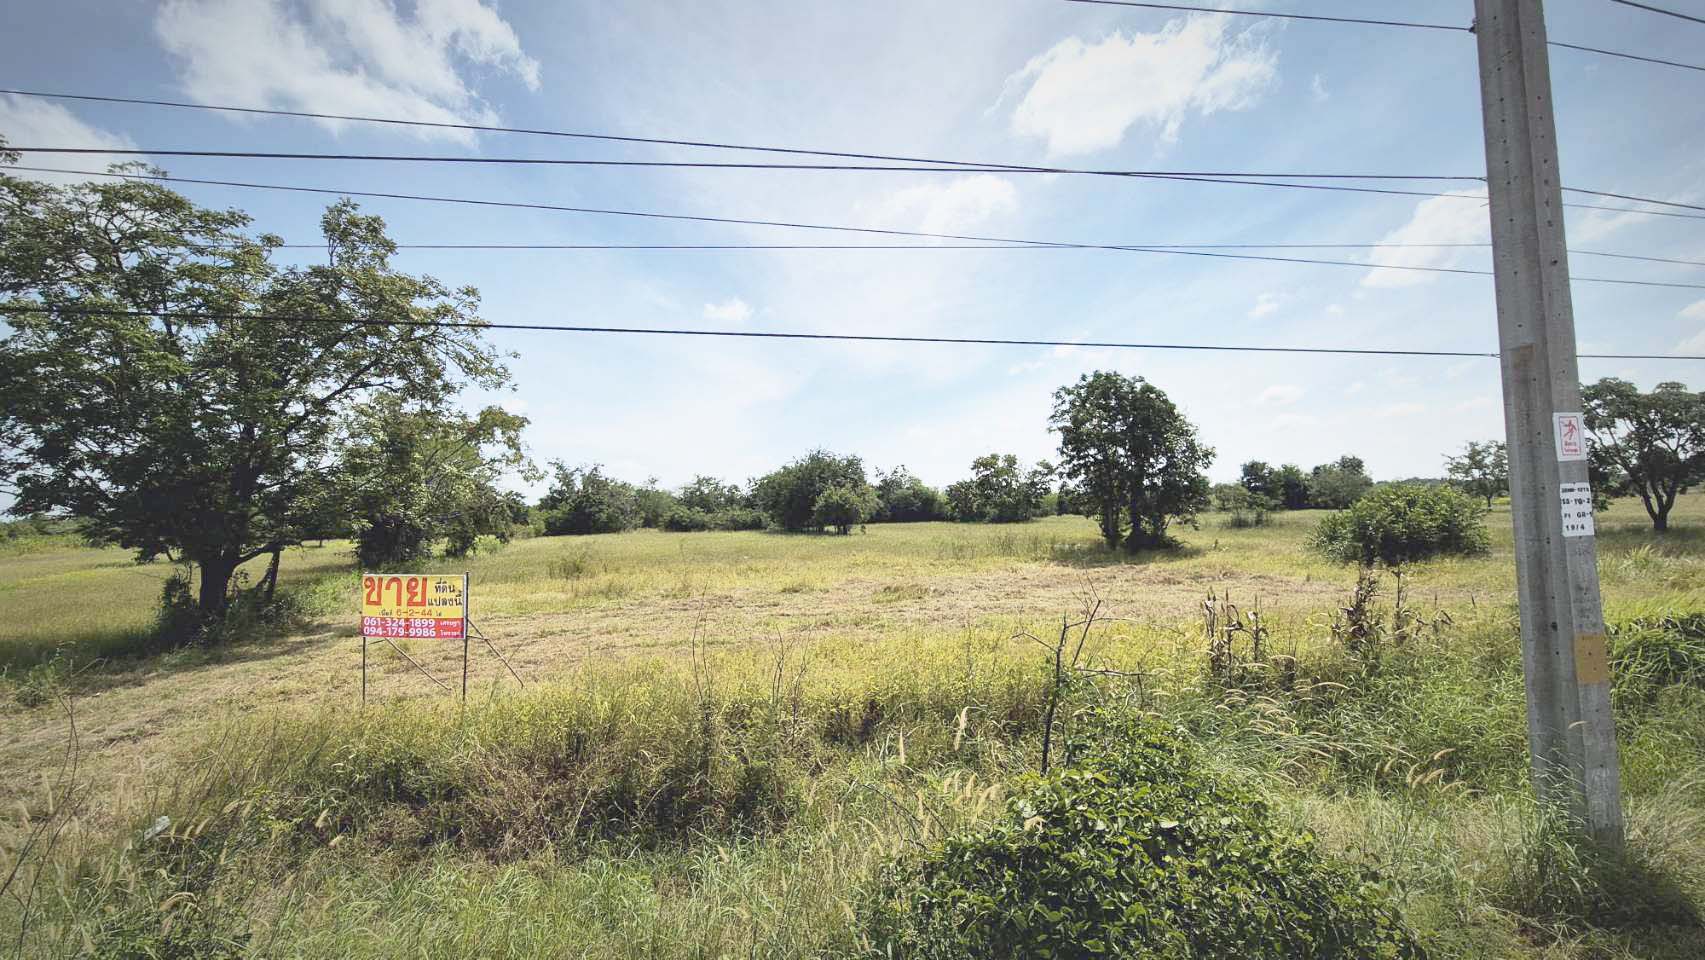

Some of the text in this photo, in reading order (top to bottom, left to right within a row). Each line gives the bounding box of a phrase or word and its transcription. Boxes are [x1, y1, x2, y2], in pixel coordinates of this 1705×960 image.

[364, 576, 428, 606] ขาย
[434, 578, 455, 593] ที่ดิน
[428, 589, 463, 606] แปลงนี้
[363, 617, 435, 628] 061-324-1899
[363, 626, 436, 637] 094-179-9986
